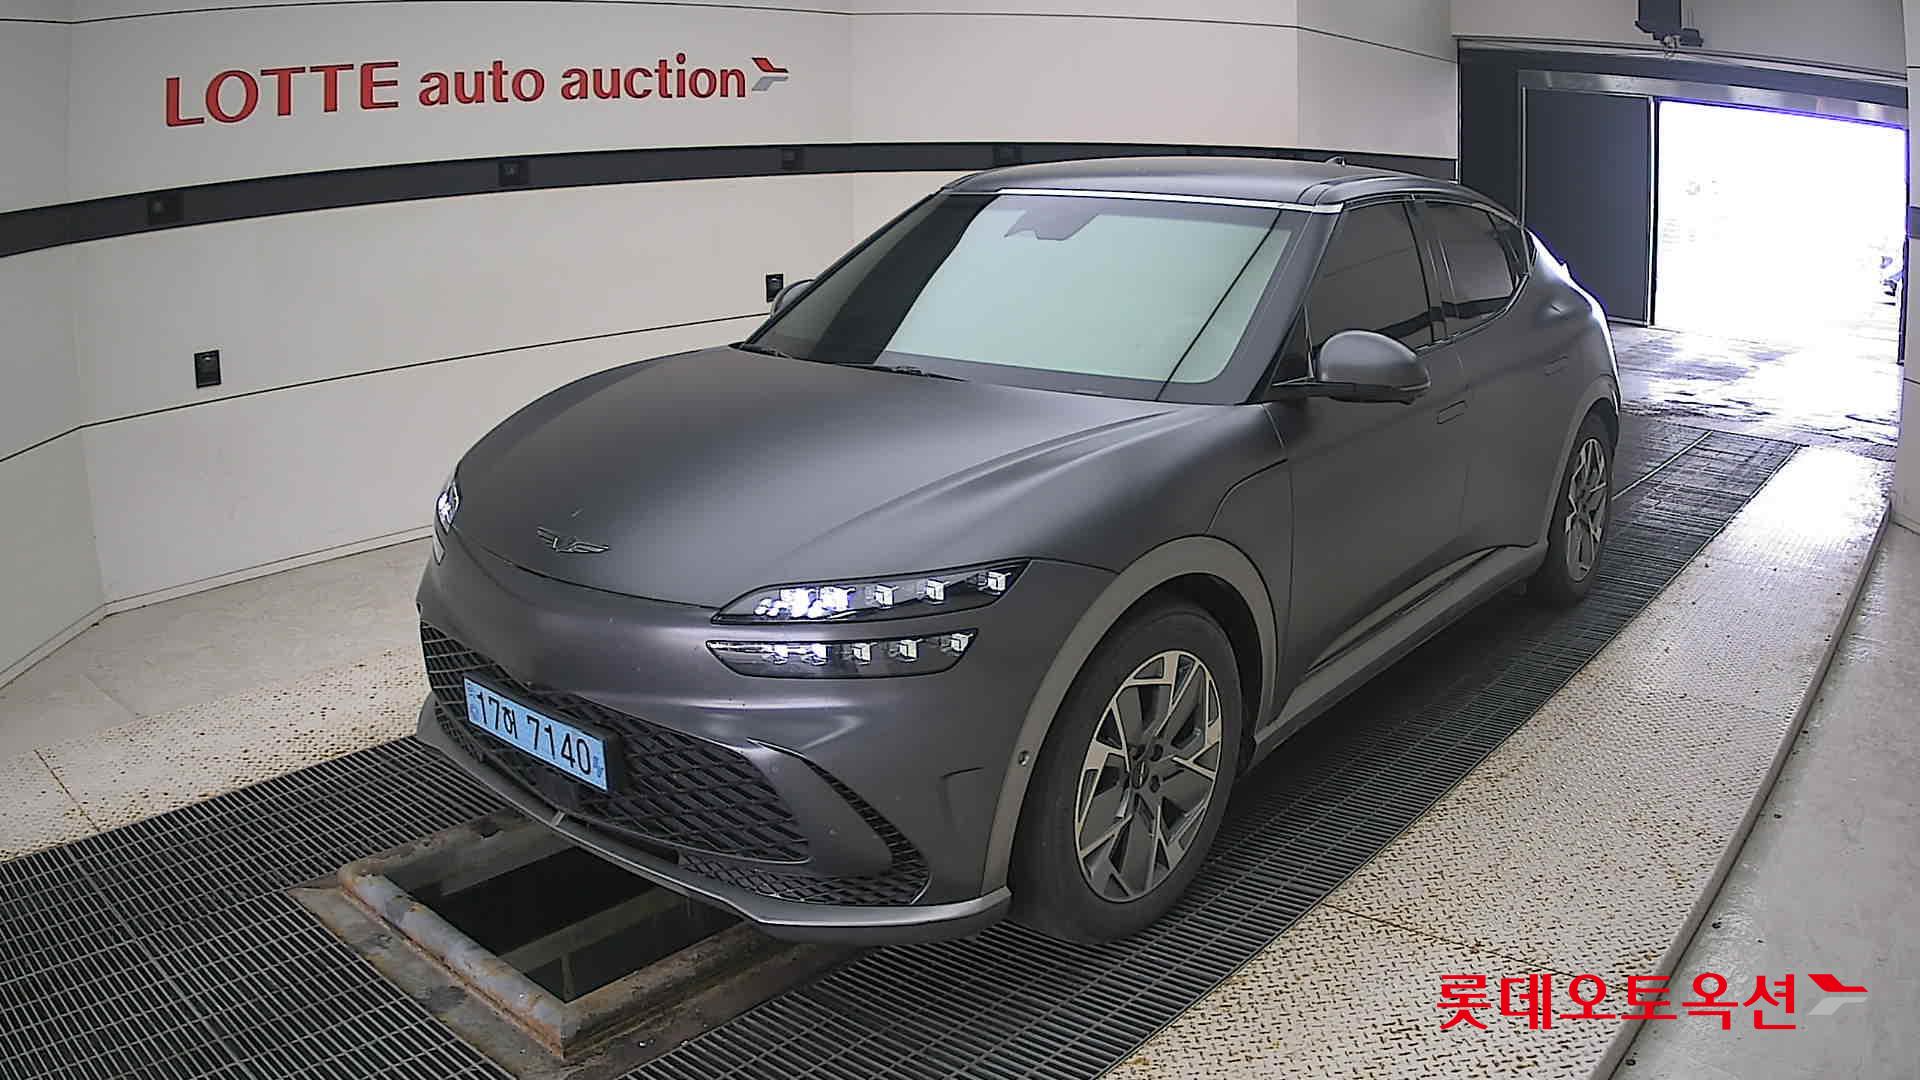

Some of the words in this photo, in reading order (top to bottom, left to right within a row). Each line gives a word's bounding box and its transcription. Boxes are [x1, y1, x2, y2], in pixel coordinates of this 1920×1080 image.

[165, 61, 399, 127] LOTTE
[418, 59, 546, 107] auto
[560, 52, 748, 101] auction
[476, 691, 518, 739] 17허
[527, 714, 592, 775] 7140
